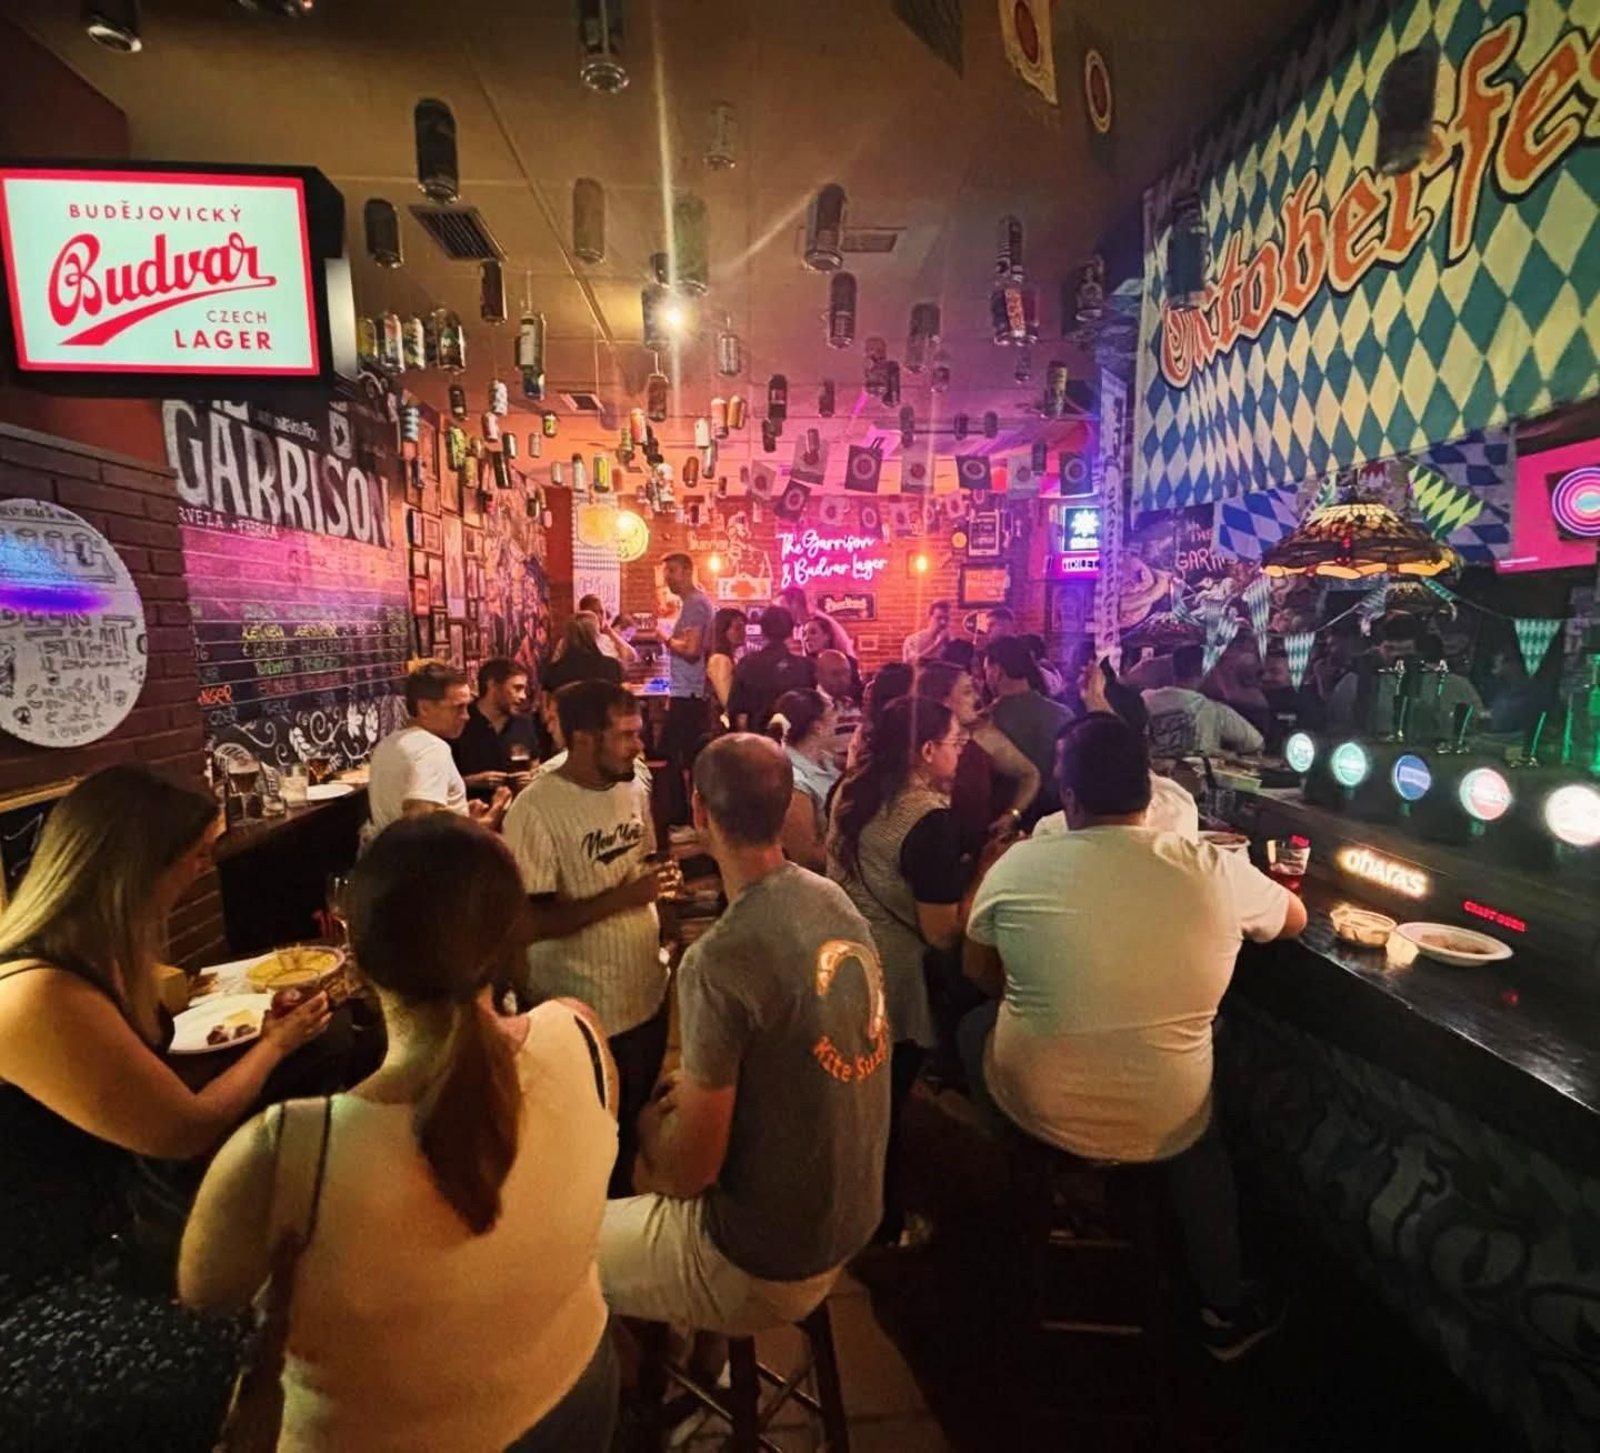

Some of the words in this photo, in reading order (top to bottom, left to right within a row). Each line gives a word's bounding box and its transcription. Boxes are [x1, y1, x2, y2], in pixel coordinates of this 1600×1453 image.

[69, 201, 243, 222] BUDĚJOVICKÝ
[48, 231, 277, 327] Budvar
[206, 310, 268, 325] CZECH
[174, 329, 273, 350] LAGER
[161, 399, 392, 549] GARRISON
[775, 532, 804, 561] The
[580, 829, 614, 859] New
